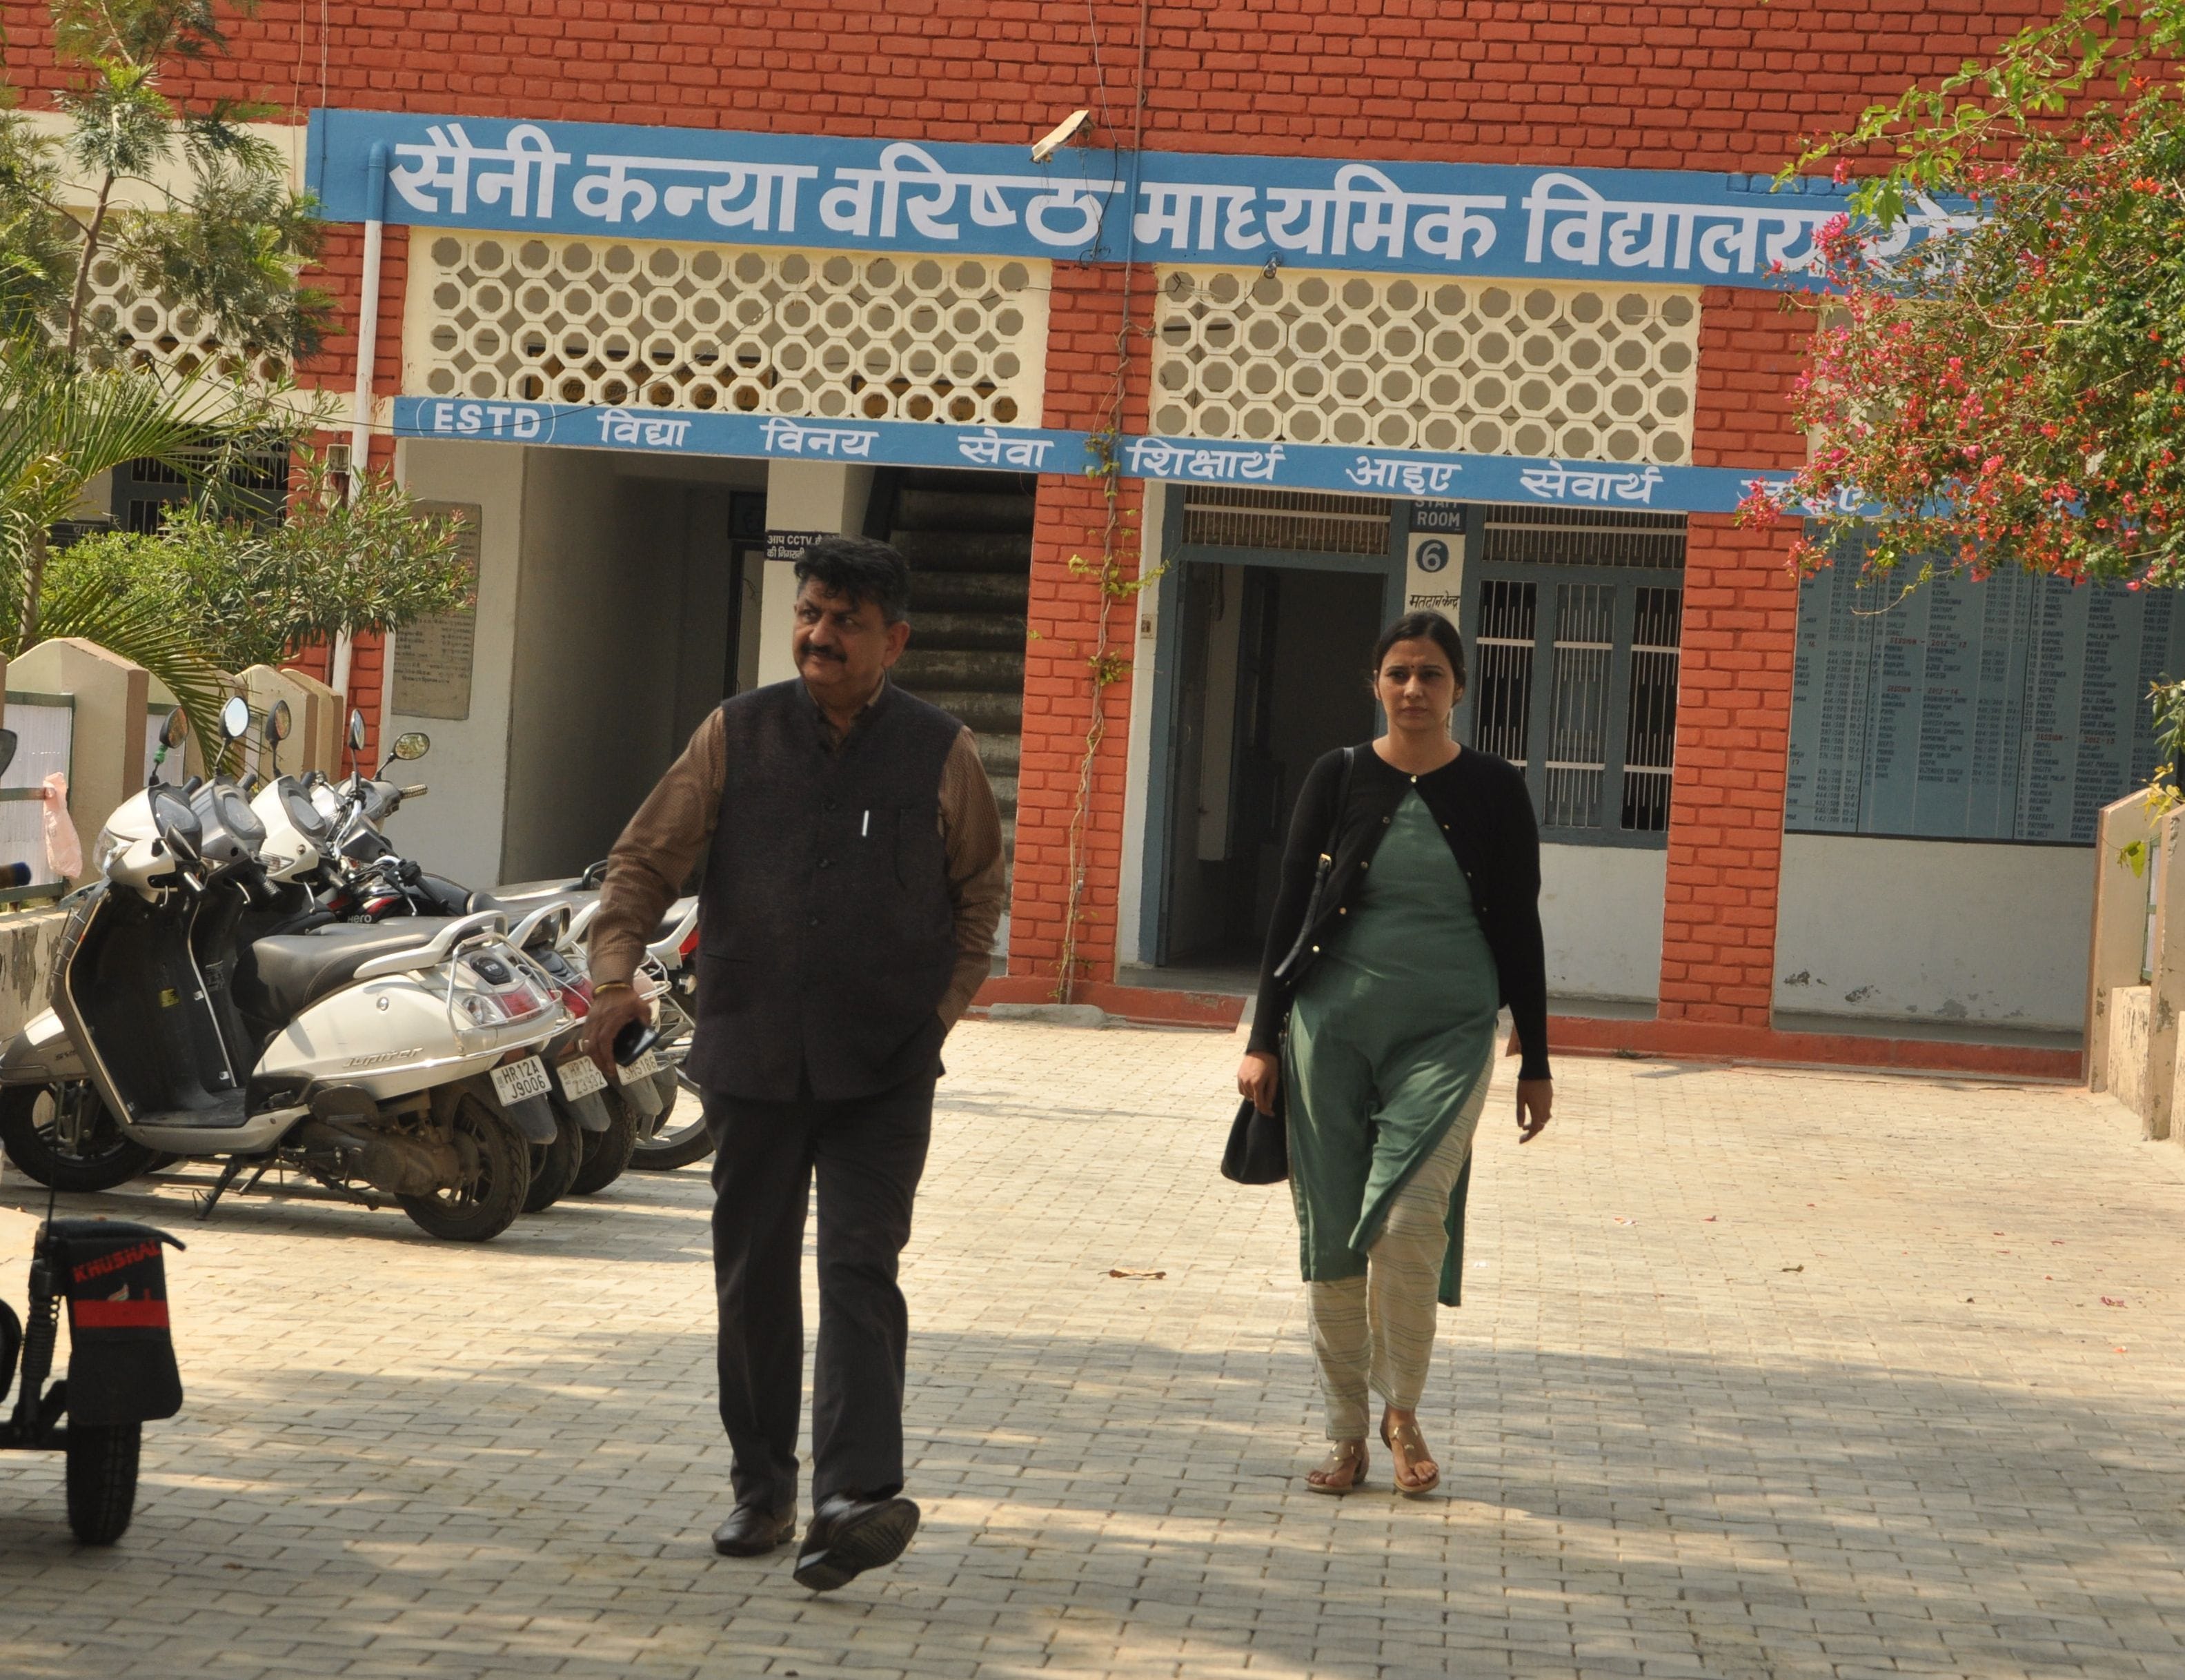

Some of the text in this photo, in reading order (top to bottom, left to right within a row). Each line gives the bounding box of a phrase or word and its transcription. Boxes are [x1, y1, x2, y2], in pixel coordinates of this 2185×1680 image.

[389, 123, 571, 219] सैनी
[573, 154, 818, 233] कन्या
[818, 142, 1126, 247] वरिष्ठ
[1133, 164, 1506, 261] माध्यमिक
[1522, 173, 1850, 277] विद्यालय
[597, 408, 1054, 468] विद्या विनय सेवा
[1345, 455, 1462, 495] आइए
[1520, 460, 1663, 504] सेवार्थ
[1417, 511, 1461, 527] ROOM
[767, 535, 785, 545] आप
[787, 535, 812, 546] CCTV
[1422, 543, 1442, 571] 6
[1890, 637, 1917, 645] SESSION
[2036, 733, 2064, 742] SESSION
